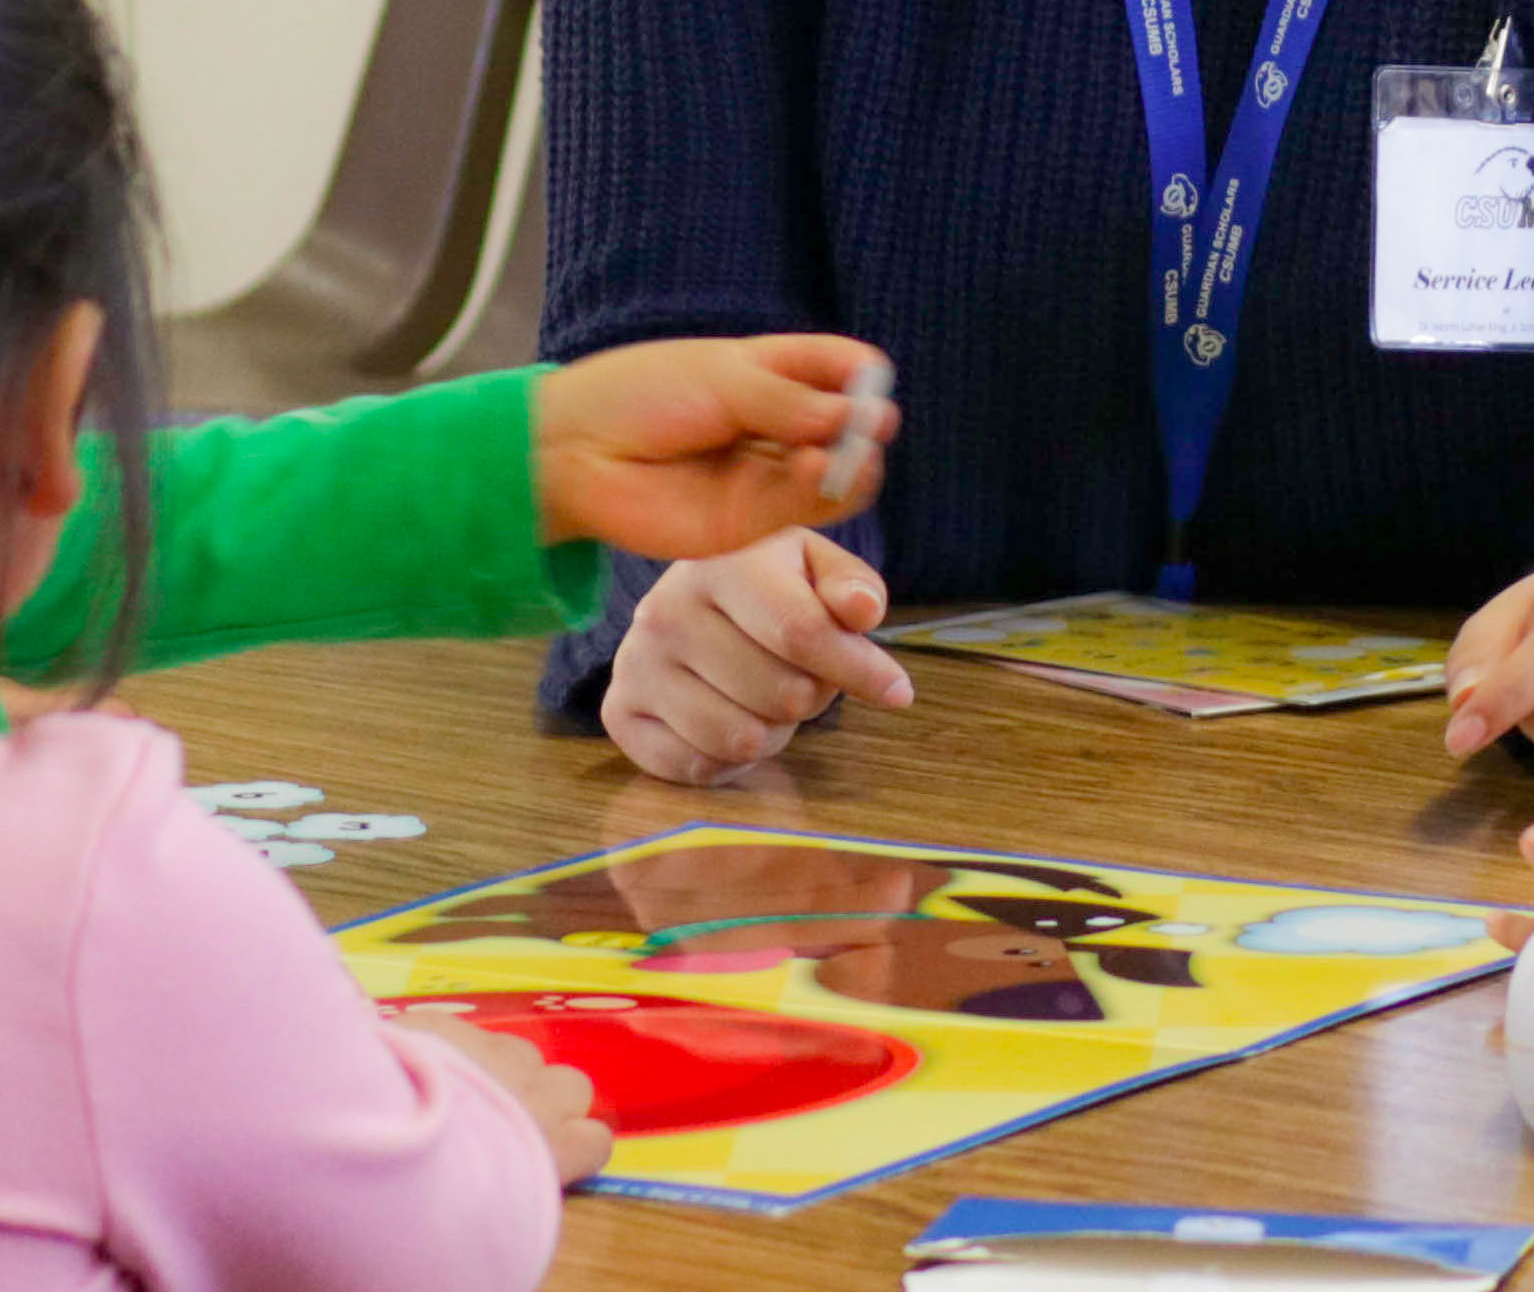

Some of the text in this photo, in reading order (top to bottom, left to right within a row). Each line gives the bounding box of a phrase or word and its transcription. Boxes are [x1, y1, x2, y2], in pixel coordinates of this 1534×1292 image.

[1163, 21, 1184, 96] SCHOLARS
[1196, 177, 1241, 319] GUARDIAN SCHOLARS
[1219, 224, 1243, 284] CSUMB
[1164, 268, 1180, 325] CSUMB
[1413, 267, 1498, 292] Service
